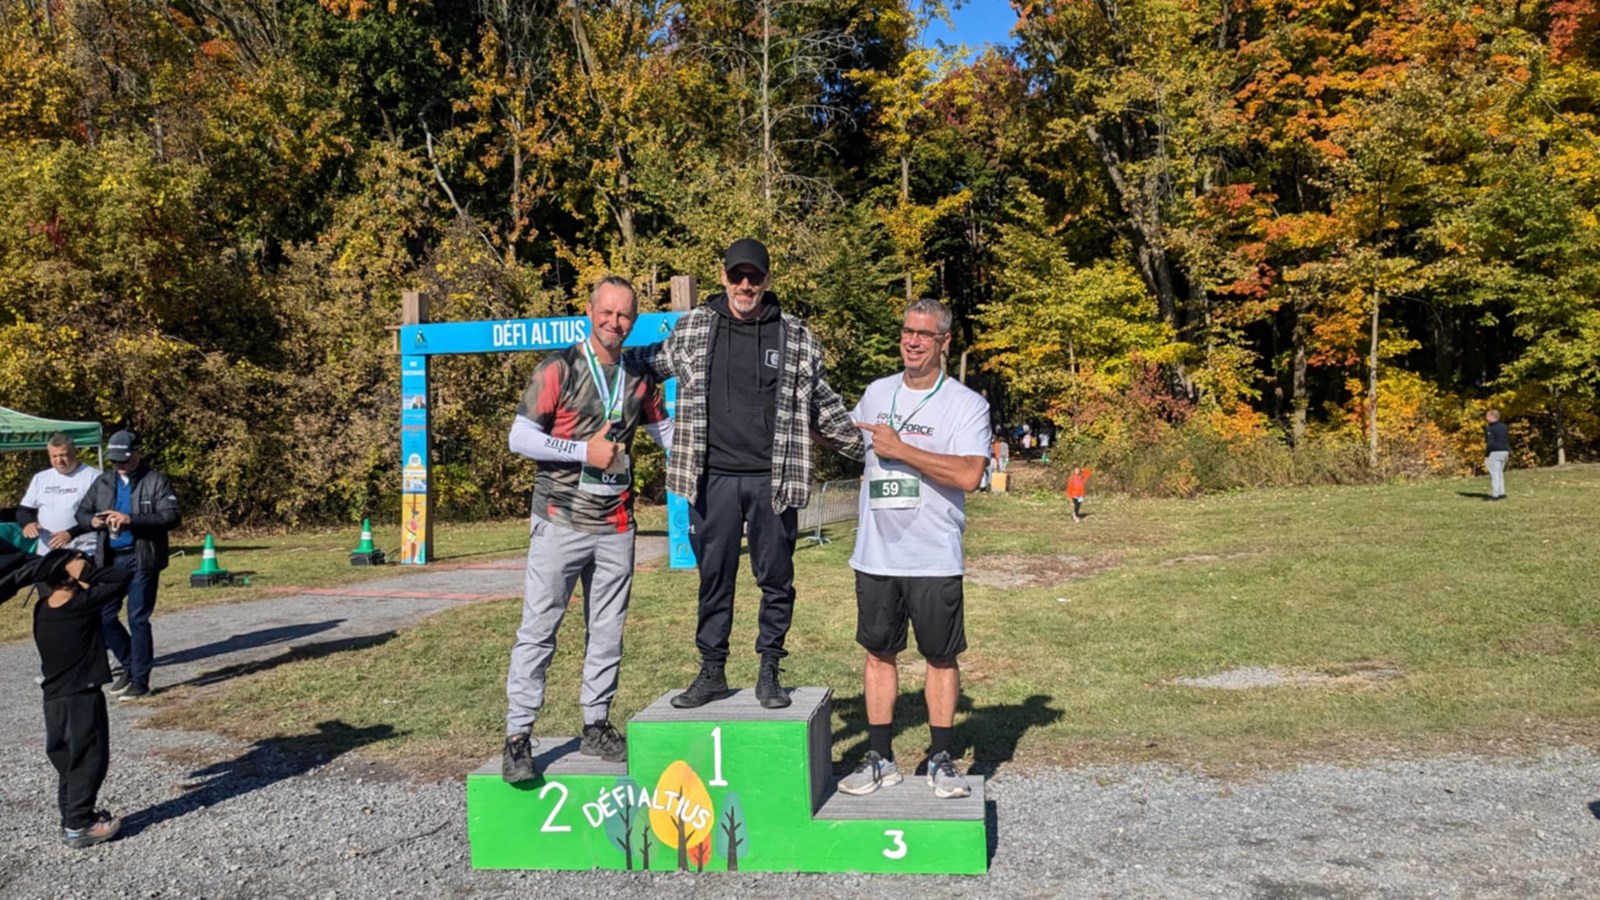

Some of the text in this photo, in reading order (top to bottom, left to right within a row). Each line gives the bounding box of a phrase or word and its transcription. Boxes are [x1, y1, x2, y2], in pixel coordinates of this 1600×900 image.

[493, 320, 586, 347] DÉFI ALTIUS
[876, 412, 904, 422] EQUPE
[601, 472, 617, 484] 62
[882, 481, 899, 495] 59
[708, 726, 728, 787] 1
[538, 781, 572, 832] 2
[582, 785, 711, 829] DÉFI ALTIUS
[882, 829, 907, 859] 3
